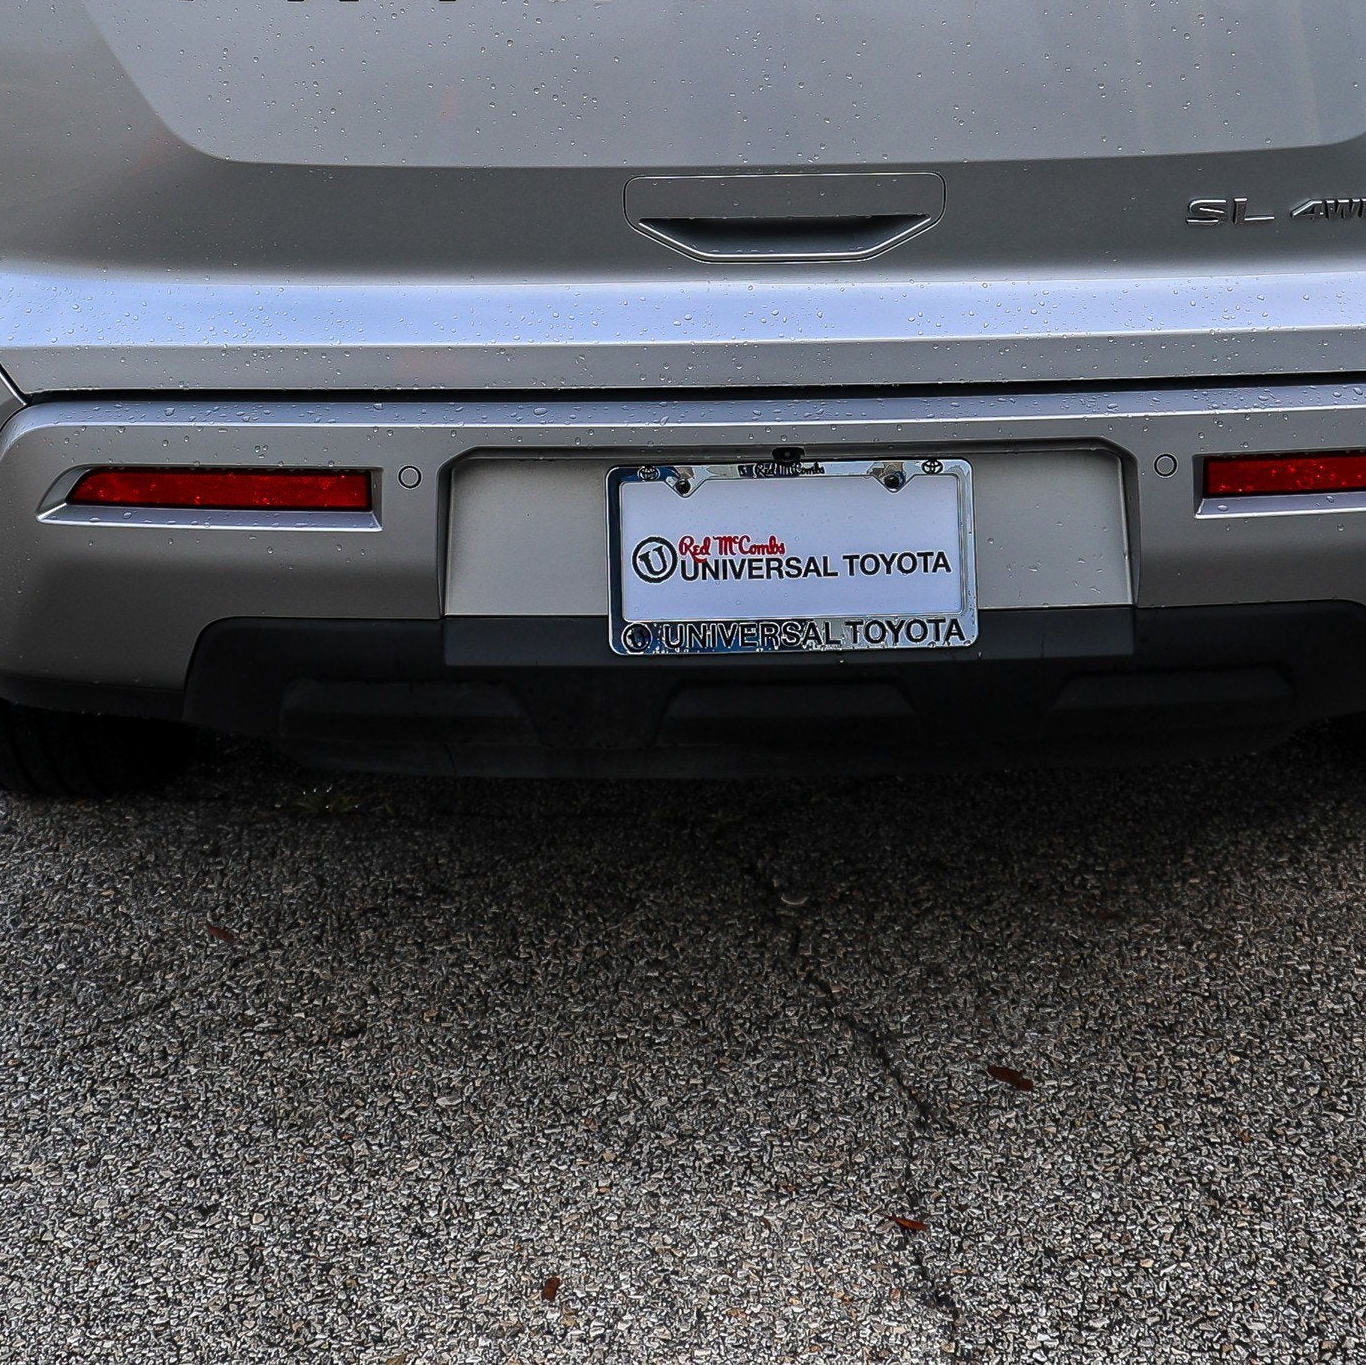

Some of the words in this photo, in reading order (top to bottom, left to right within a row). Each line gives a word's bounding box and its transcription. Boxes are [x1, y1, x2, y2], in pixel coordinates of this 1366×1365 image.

[1186, 197, 1275, 226] SL
[678, 535, 711, 573] Red
[712, 535, 786, 555] McCombs
[680, 555, 839, 581] UNIVERSAL
[843, 551, 952, 577] TOYOTA
[663, 620, 842, 648] UNIVERSAL
[844, 618, 967, 645] TOYOTA
